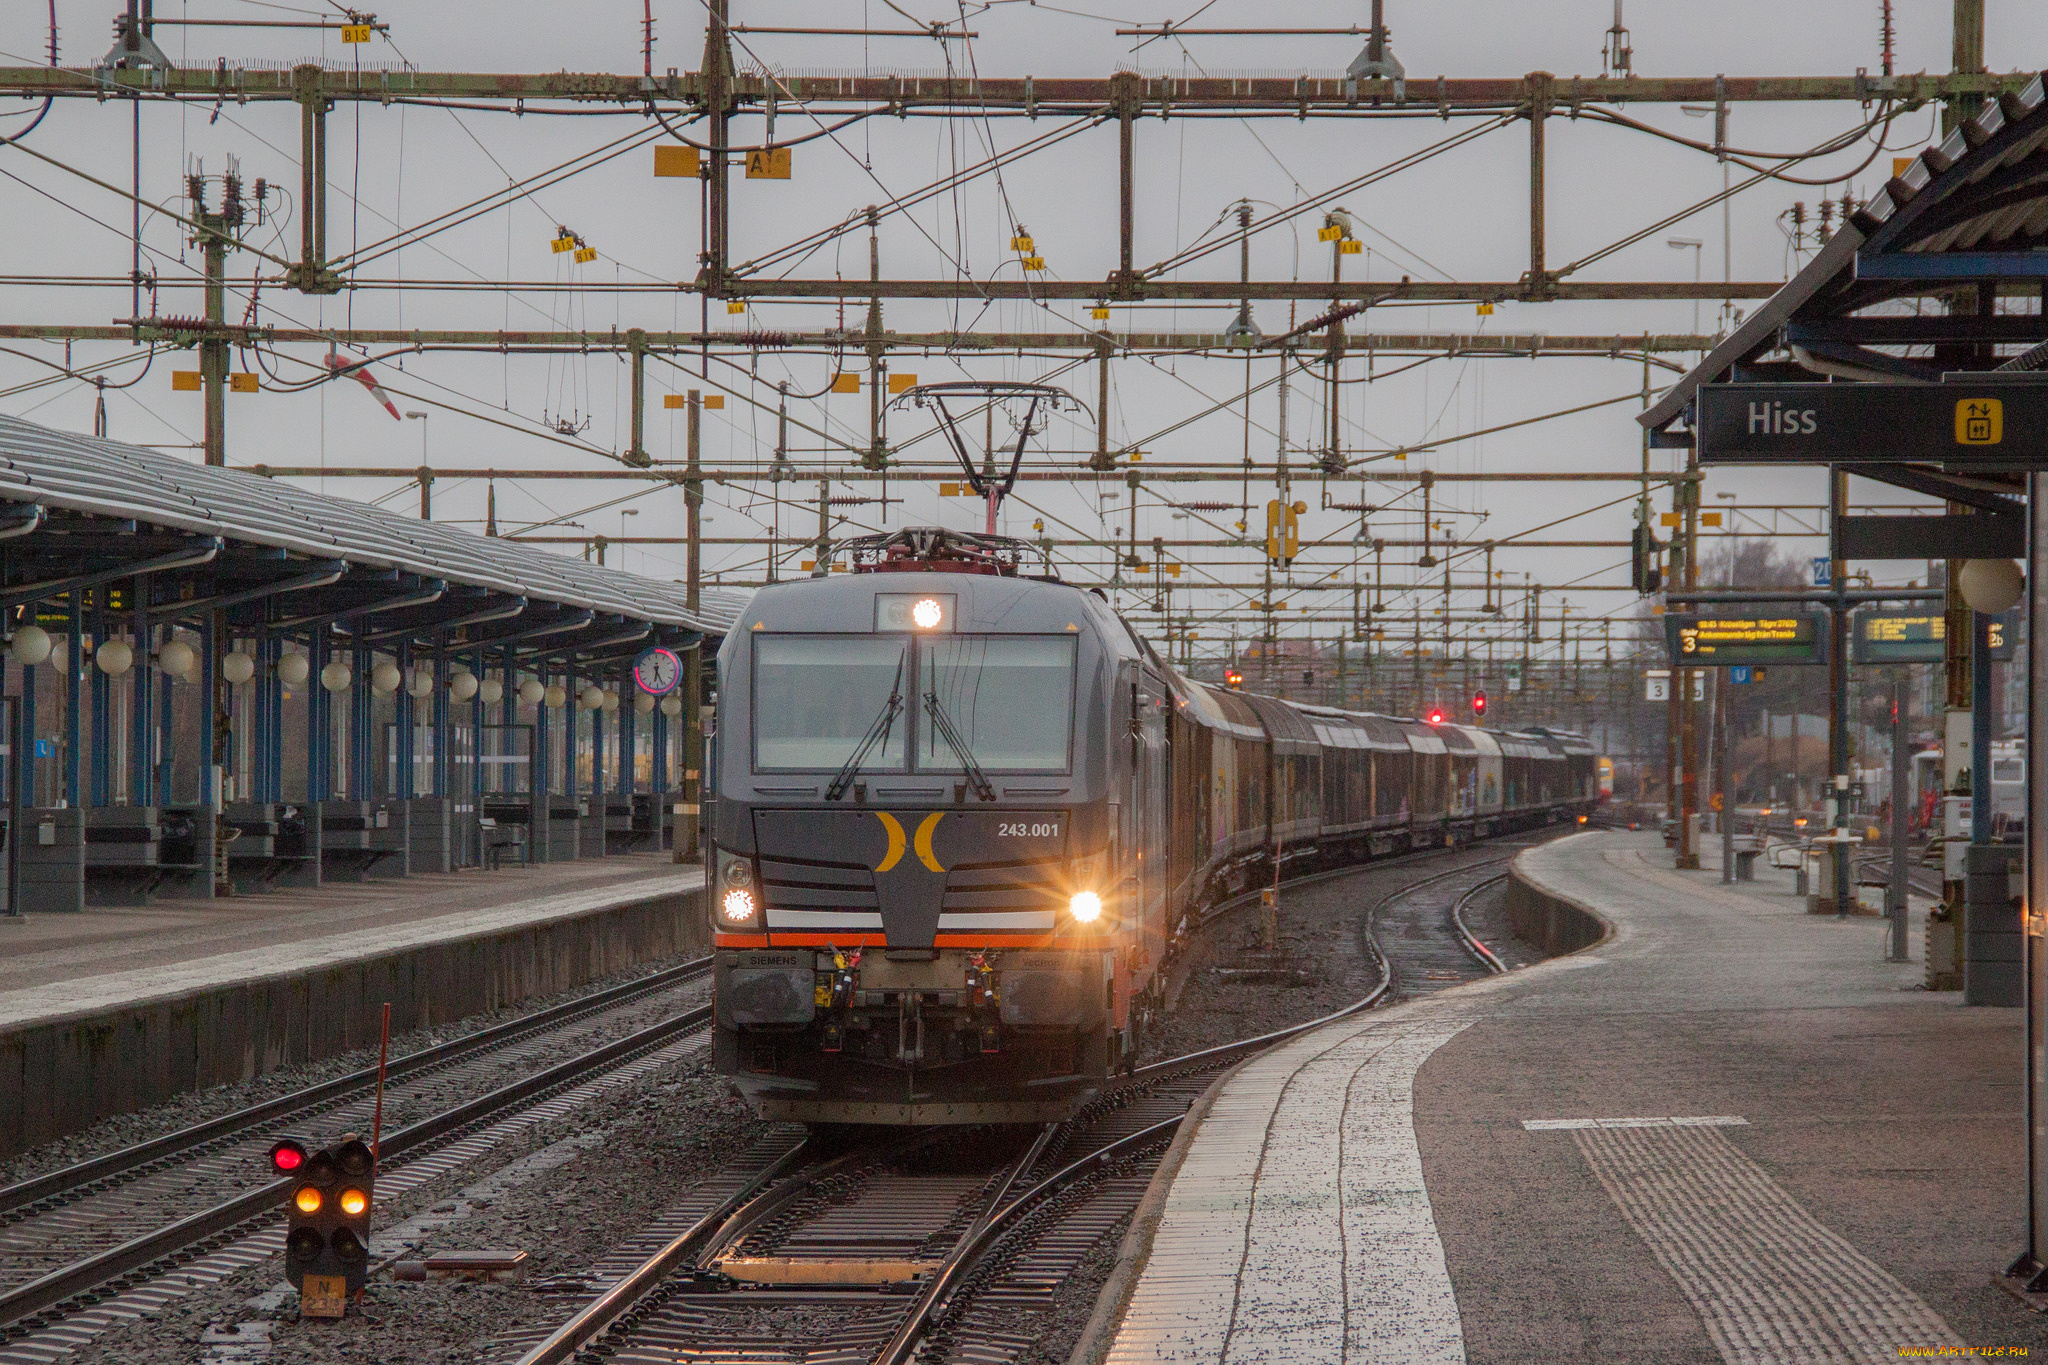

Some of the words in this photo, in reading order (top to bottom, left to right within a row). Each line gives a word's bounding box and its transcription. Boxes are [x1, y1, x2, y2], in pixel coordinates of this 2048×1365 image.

[1749, 401, 1817, 434] Hiss
[16, 605, 25, 619] 7
[1683, 637, 1695, 652] 3
[1655, 686, 1662, 697] 3
[999, 823, 1058, 837] 243.001
[750, 956, 797, 965] SIEMENS
[318, 1281, 330, 1294] N
